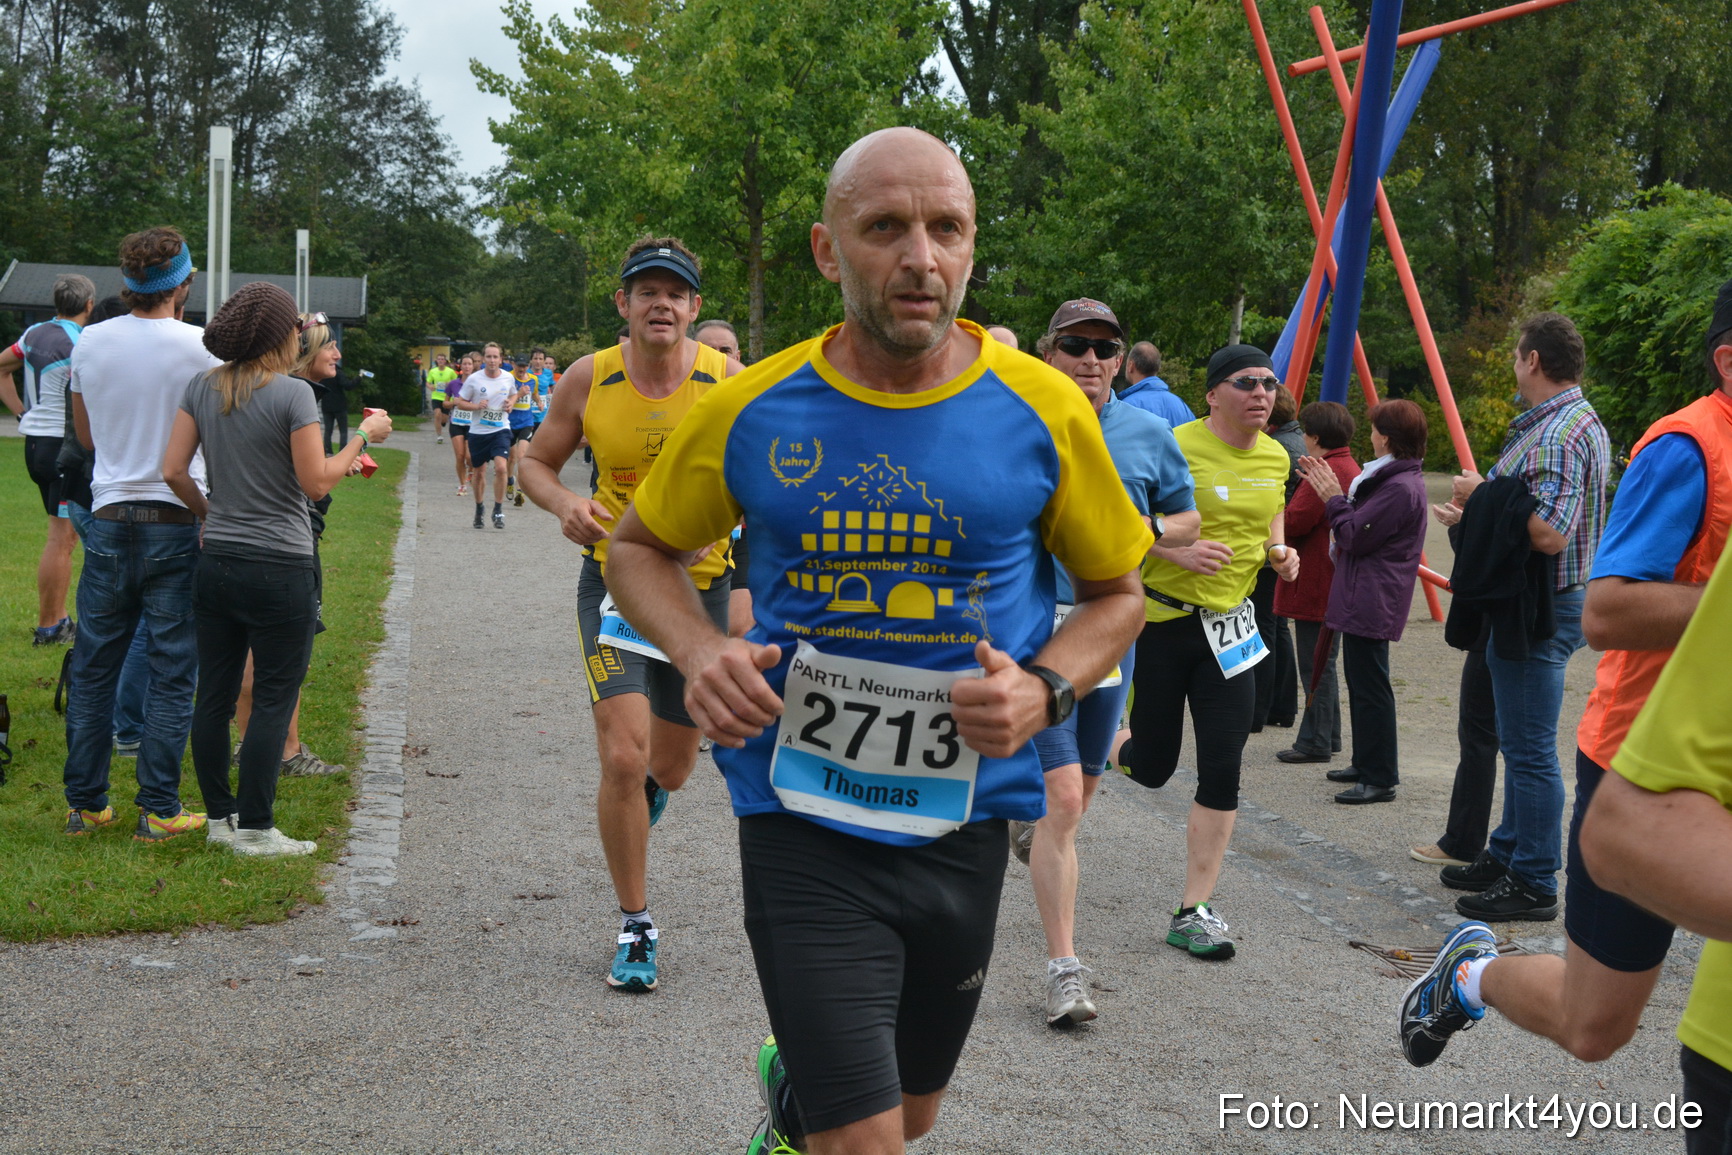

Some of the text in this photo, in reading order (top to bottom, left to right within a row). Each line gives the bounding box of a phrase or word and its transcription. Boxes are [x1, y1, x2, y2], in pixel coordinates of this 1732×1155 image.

[454, 410, 471, 419] 2499
[482, 410, 503, 420] 2928
[789, 443, 802, 453] 15
[779, 457, 810, 468] Jahre
[611, 472, 637, 482] Seidl
[804, 558, 948, 575] 21.September 2014
[784, 621, 978, 644] www.stadtlauf-neumarkt.de
[1211, 604, 1255, 648] 2752
[593, 657, 606, 680] Team
[792, 658, 953, 704] PARTL Neumarkt
[798, 691, 960, 770] 2713
[785, 734, 793, 745] A
[822, 766, 921, 808] Thomas
